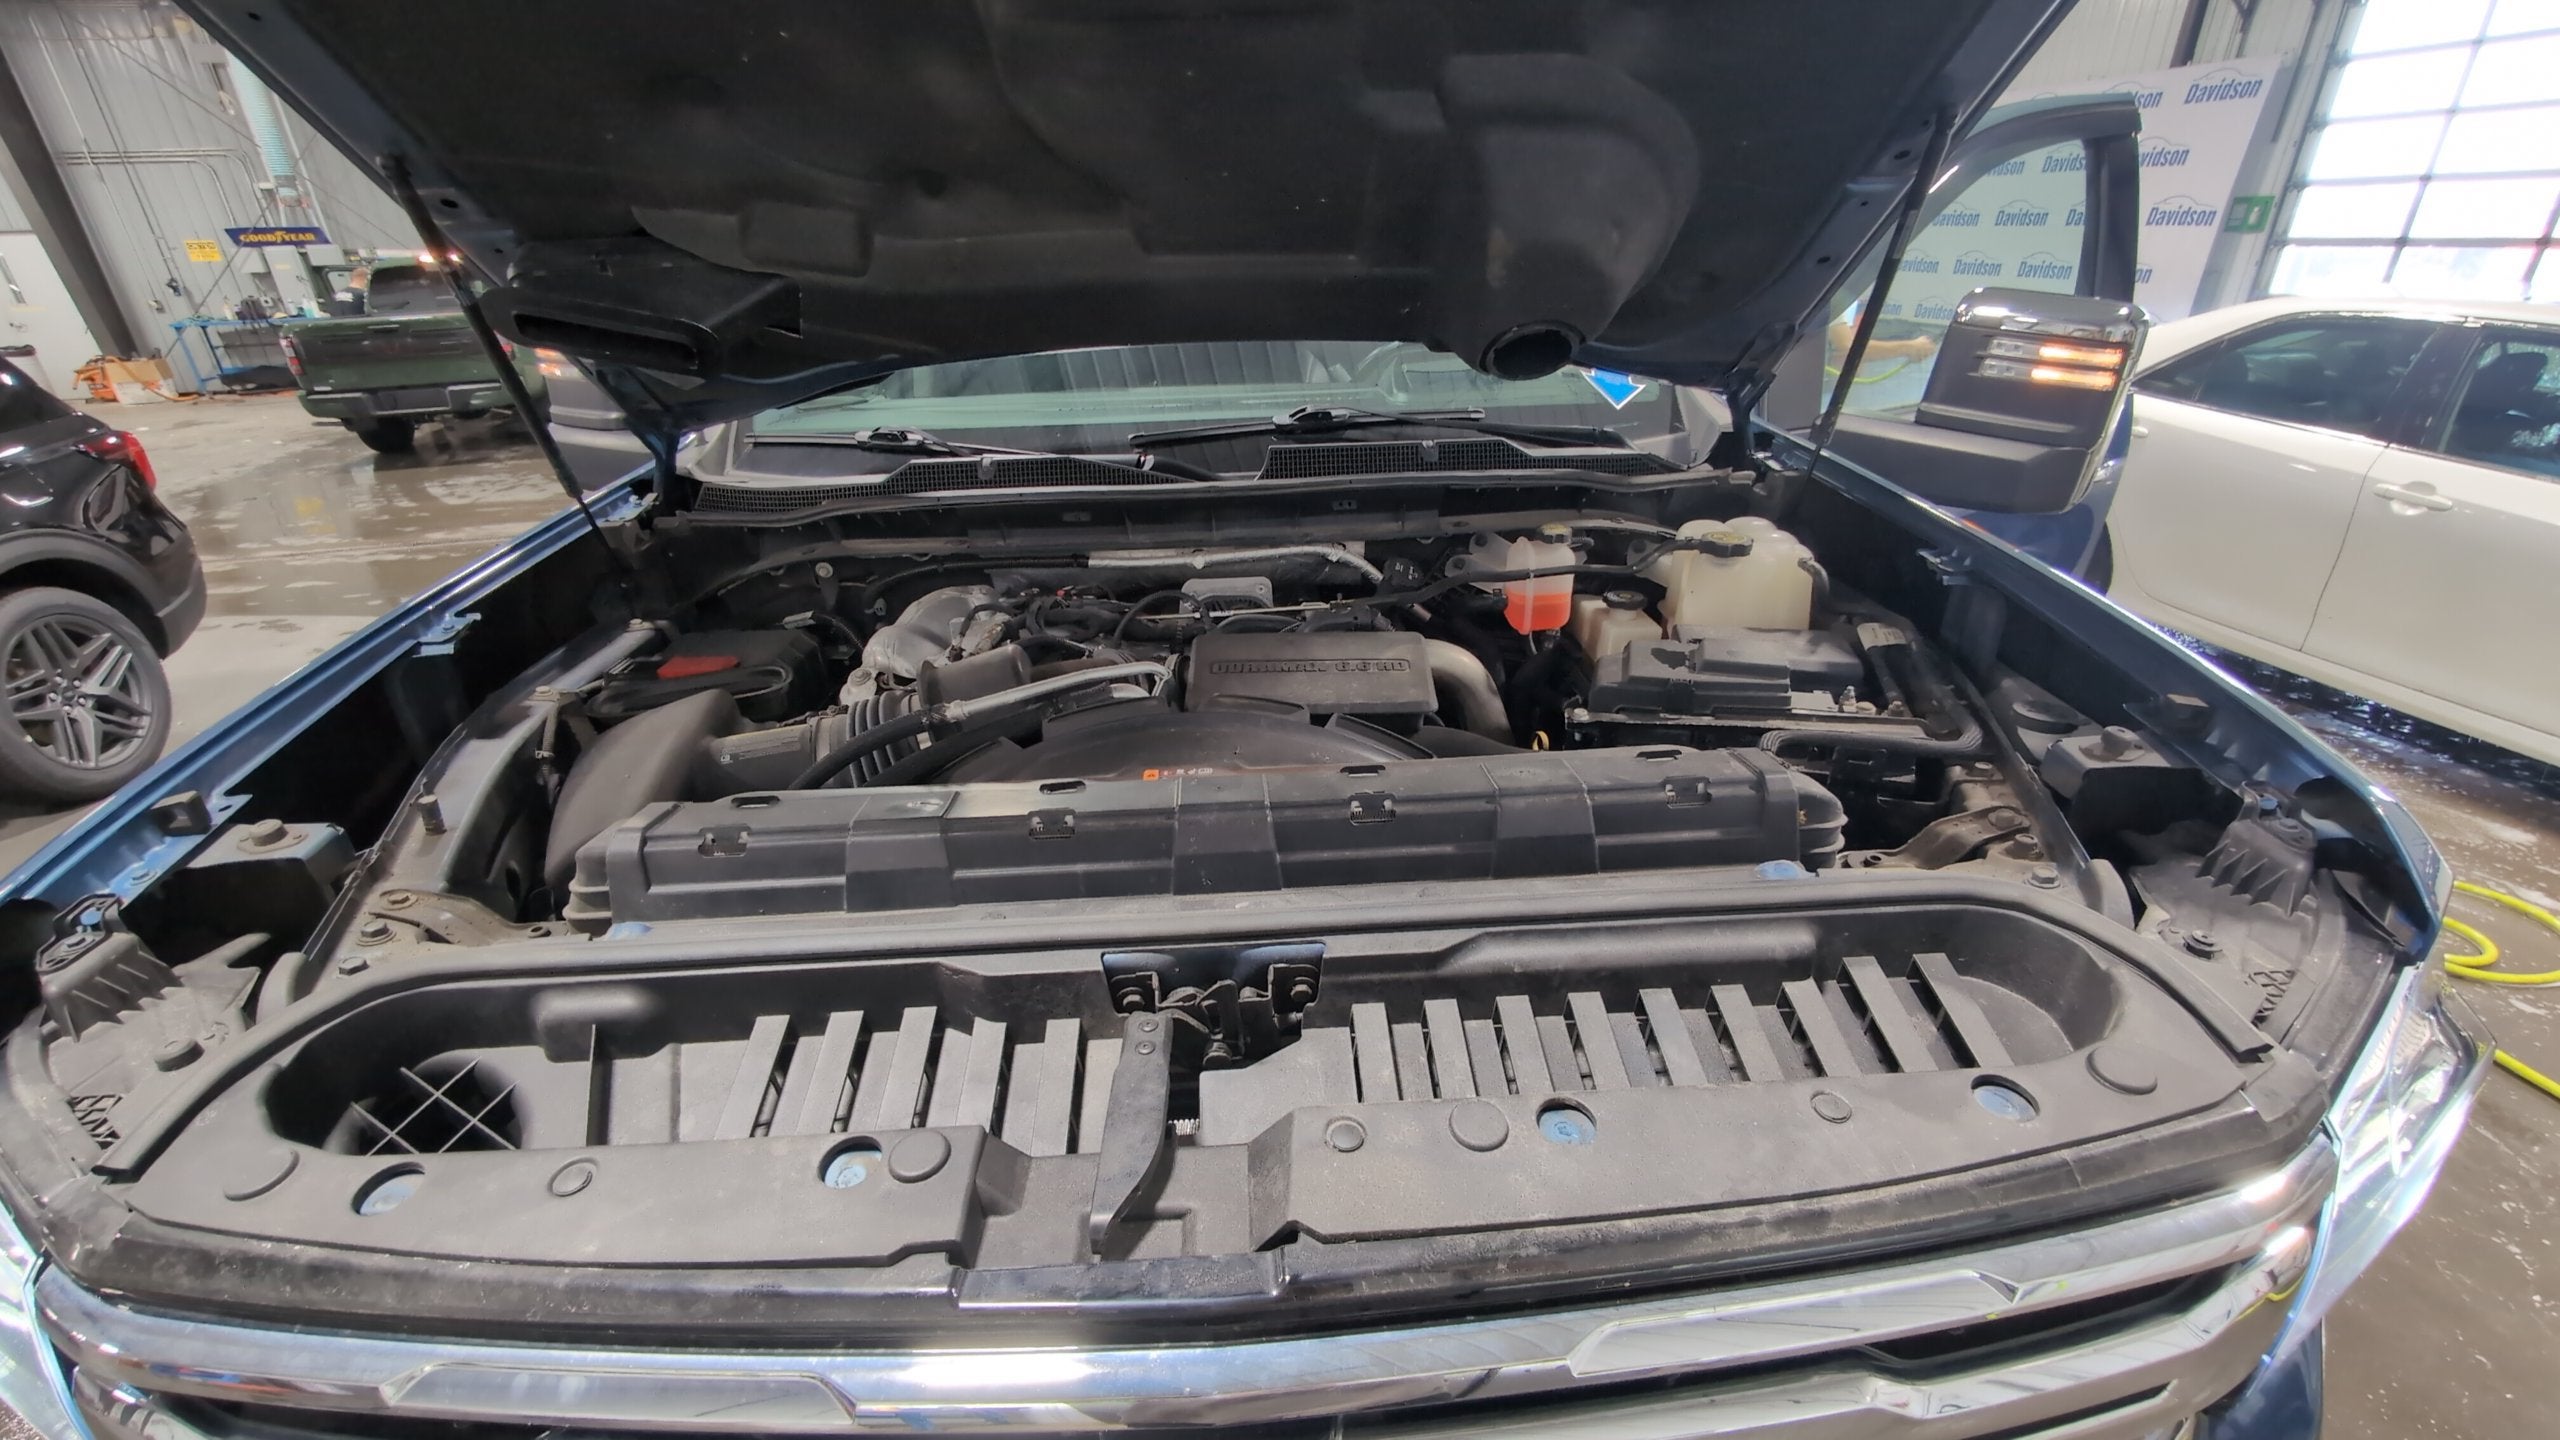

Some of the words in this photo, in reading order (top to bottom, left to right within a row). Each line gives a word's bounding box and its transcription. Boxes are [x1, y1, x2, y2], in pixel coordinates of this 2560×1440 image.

[2184, 77, 2263, 105] Davidson
[2042, 153, 2086, 173] Davids
[2140, 147, 2190, 168] vidson
[1995, 208, 2049, 227] Davidson
[2145, 205, 2218, 227] Davidson
[239, 230, 316, 243] GOODYEAR
[1900, 256, 1940, 275] avidson
[1953, 257, 2002, 277] Davidson
[2017, 259, 2072, 280] Davidson
[1914, 302, 1952, 320] Davidso
